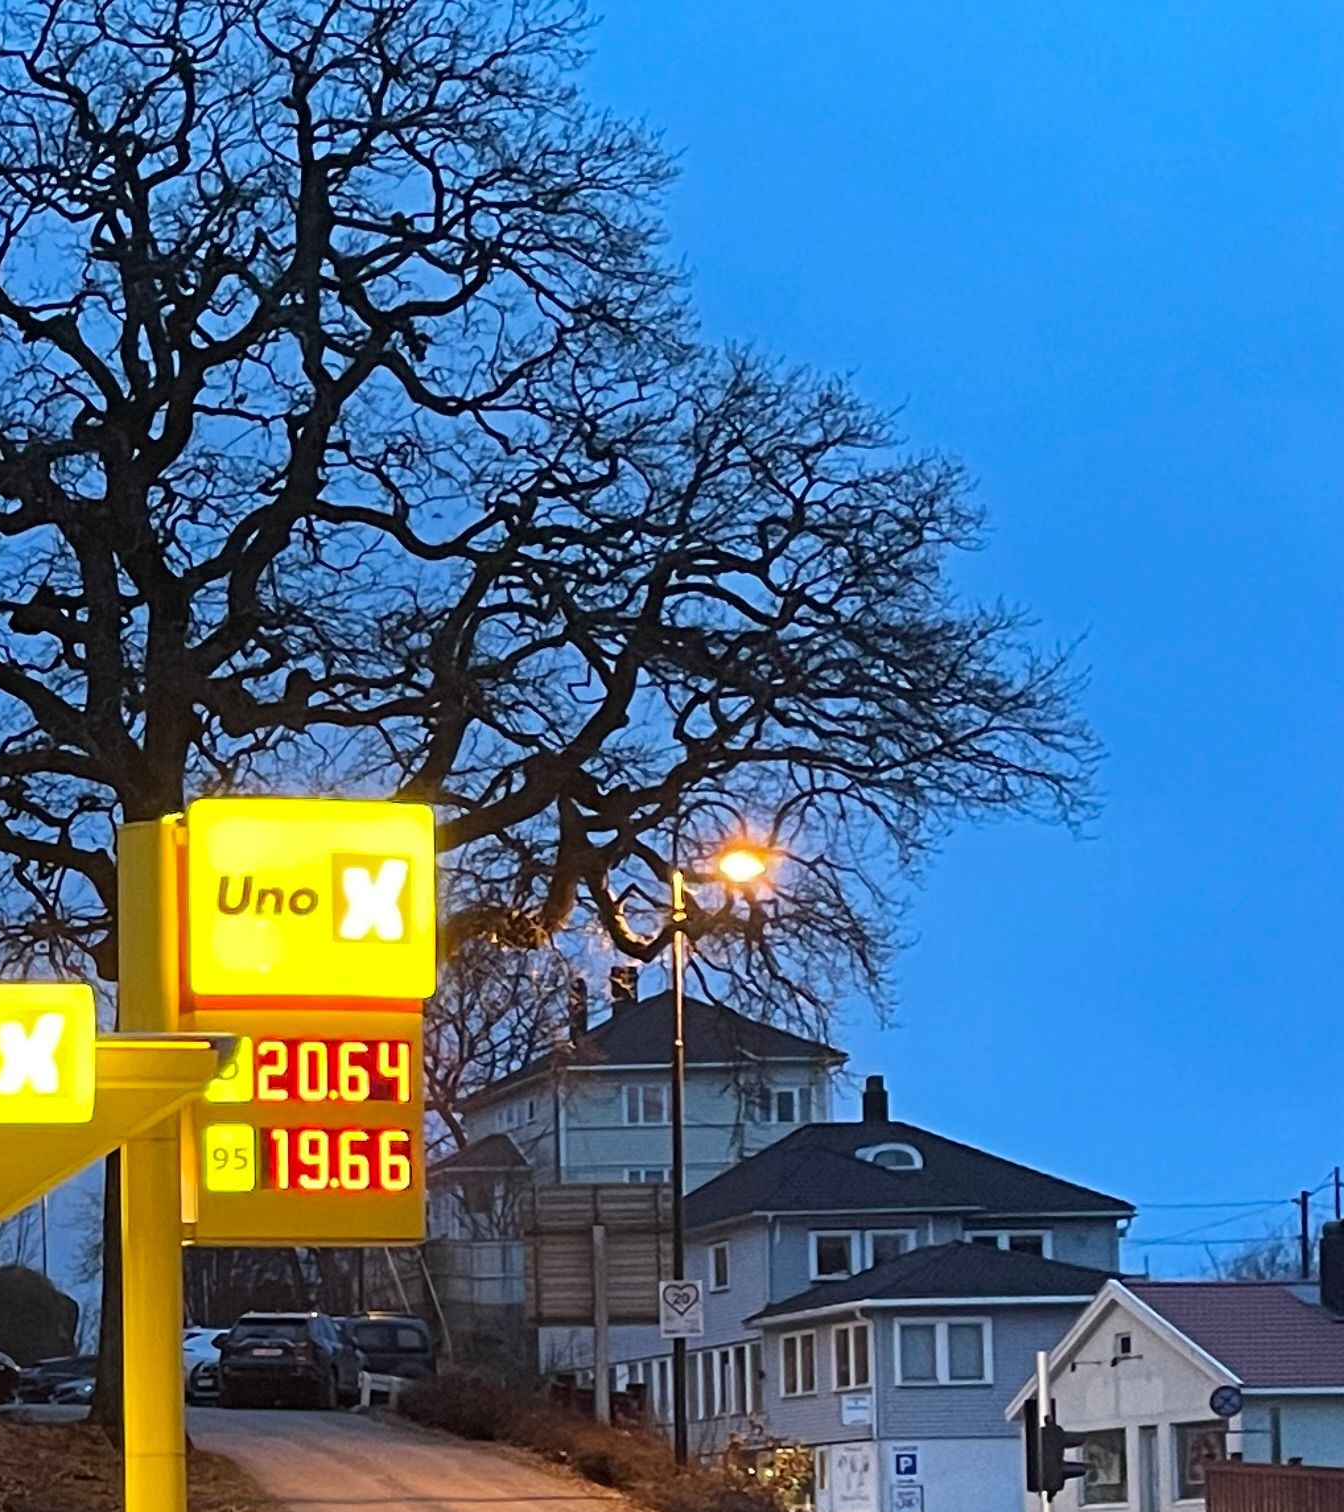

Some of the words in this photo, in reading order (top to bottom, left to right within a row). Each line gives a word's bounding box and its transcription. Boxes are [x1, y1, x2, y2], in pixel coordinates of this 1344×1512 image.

[217, 876, 319, 916] Uno
[340, 858, 410, 942] X
[257, 1040, 411, 1103] 20.64
[213, 1147, 249, 1171] 95
[271, 1128, 412, 1190] 19.66
[673, 1292, 690, 1305] 20
